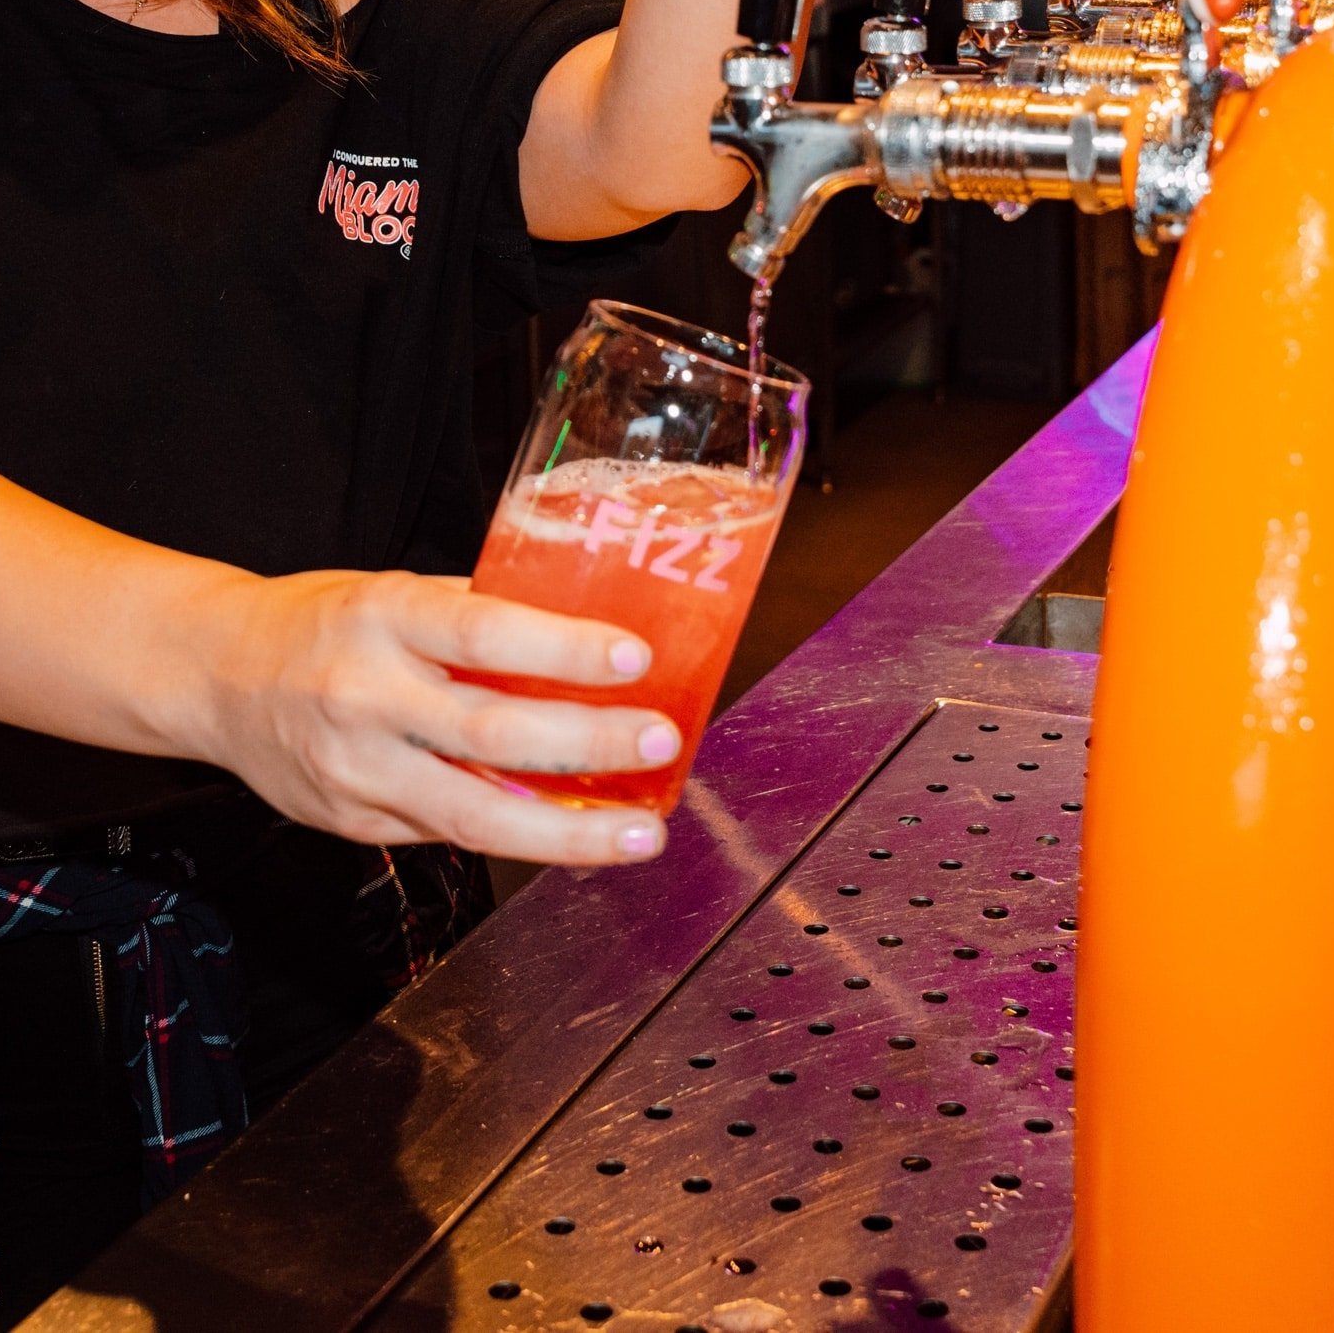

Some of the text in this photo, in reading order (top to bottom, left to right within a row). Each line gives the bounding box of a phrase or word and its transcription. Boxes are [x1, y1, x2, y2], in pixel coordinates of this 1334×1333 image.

[336, 150, 400, 167] CONQUERED
[402, 157, 419, 168] THE
[318, 160, 419, 226] Miam
[584, 498, 744, 594] FIZZ
